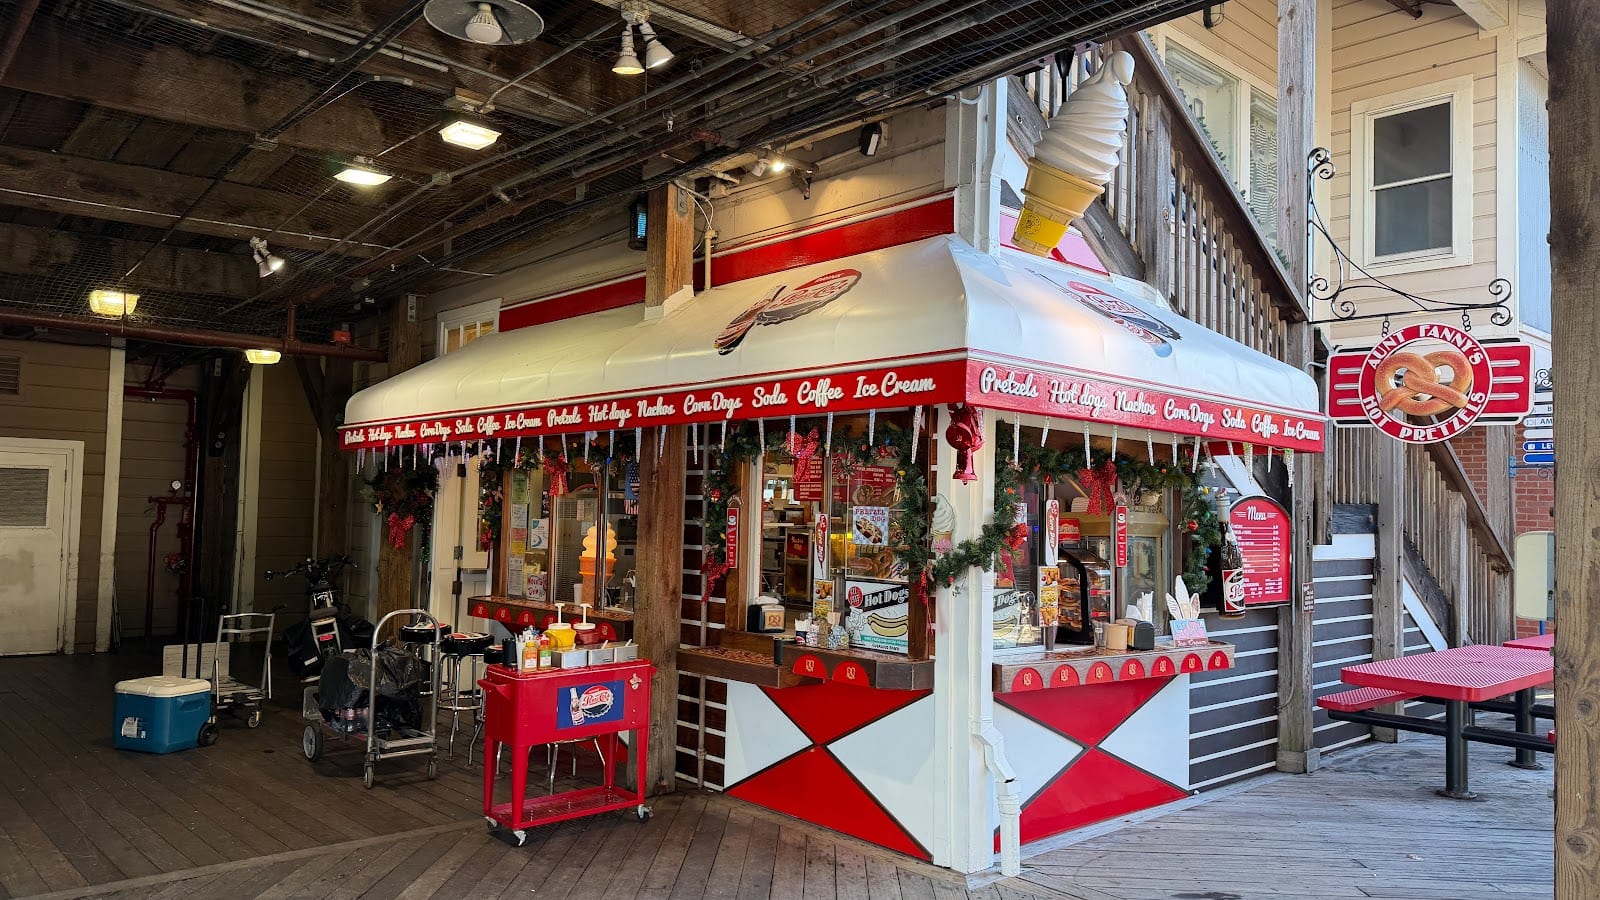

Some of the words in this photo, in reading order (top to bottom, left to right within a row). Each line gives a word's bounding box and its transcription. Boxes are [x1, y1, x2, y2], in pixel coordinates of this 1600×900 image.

[1367, 330, 1406, 370] AUNT
[1419, 325, 1484, 365] FANNY'S
[455, 419, 474, 434] Soda
[477, 415, 501, 436] Coffee
[504, 414, 517, 430] Ice
[516, 412, 542, 430] Cream
[547, 406, 582, 427] Pretzels
[588, 404, 608, 423] Hot
[608, 401, 632, 427] dogs
[637, 396, 675, 418] Nachos
[683, 394, 712, 415] Corn
[711, 391, 743, 419] Dogs
[752, 383, 788, 408] Soda
[797, 378, 844, 407] Coffee
[853, 375, 880, 399] Ice
[880, 371, 936, 398] Cream
[980, 366, 1039, 398] Pretzels
[1049, 380, 1078, 404] Hot
[1079, 383, 1107, 417] dogs
[1114, 390, 1157, 415] Nachos
[1163, 398, 1190, 420] Corn
[1189, 402, 1215, 432] Dogs
[1221, 408, 1247, 430] Soda
[1251, 413, 1279, 438] Coffee
[1283, 419, 1296, 437] Ice
[1296, 421, 1321, 440] Cream
[1363, 395, 1393, 428] HOT
[1398, 392, 1486, 440] PRETZELS
[1247, 505, 1267, 521] Menu
[864, 593, 883, 608] Hot
[883, 588, 909, 604] Dogs
